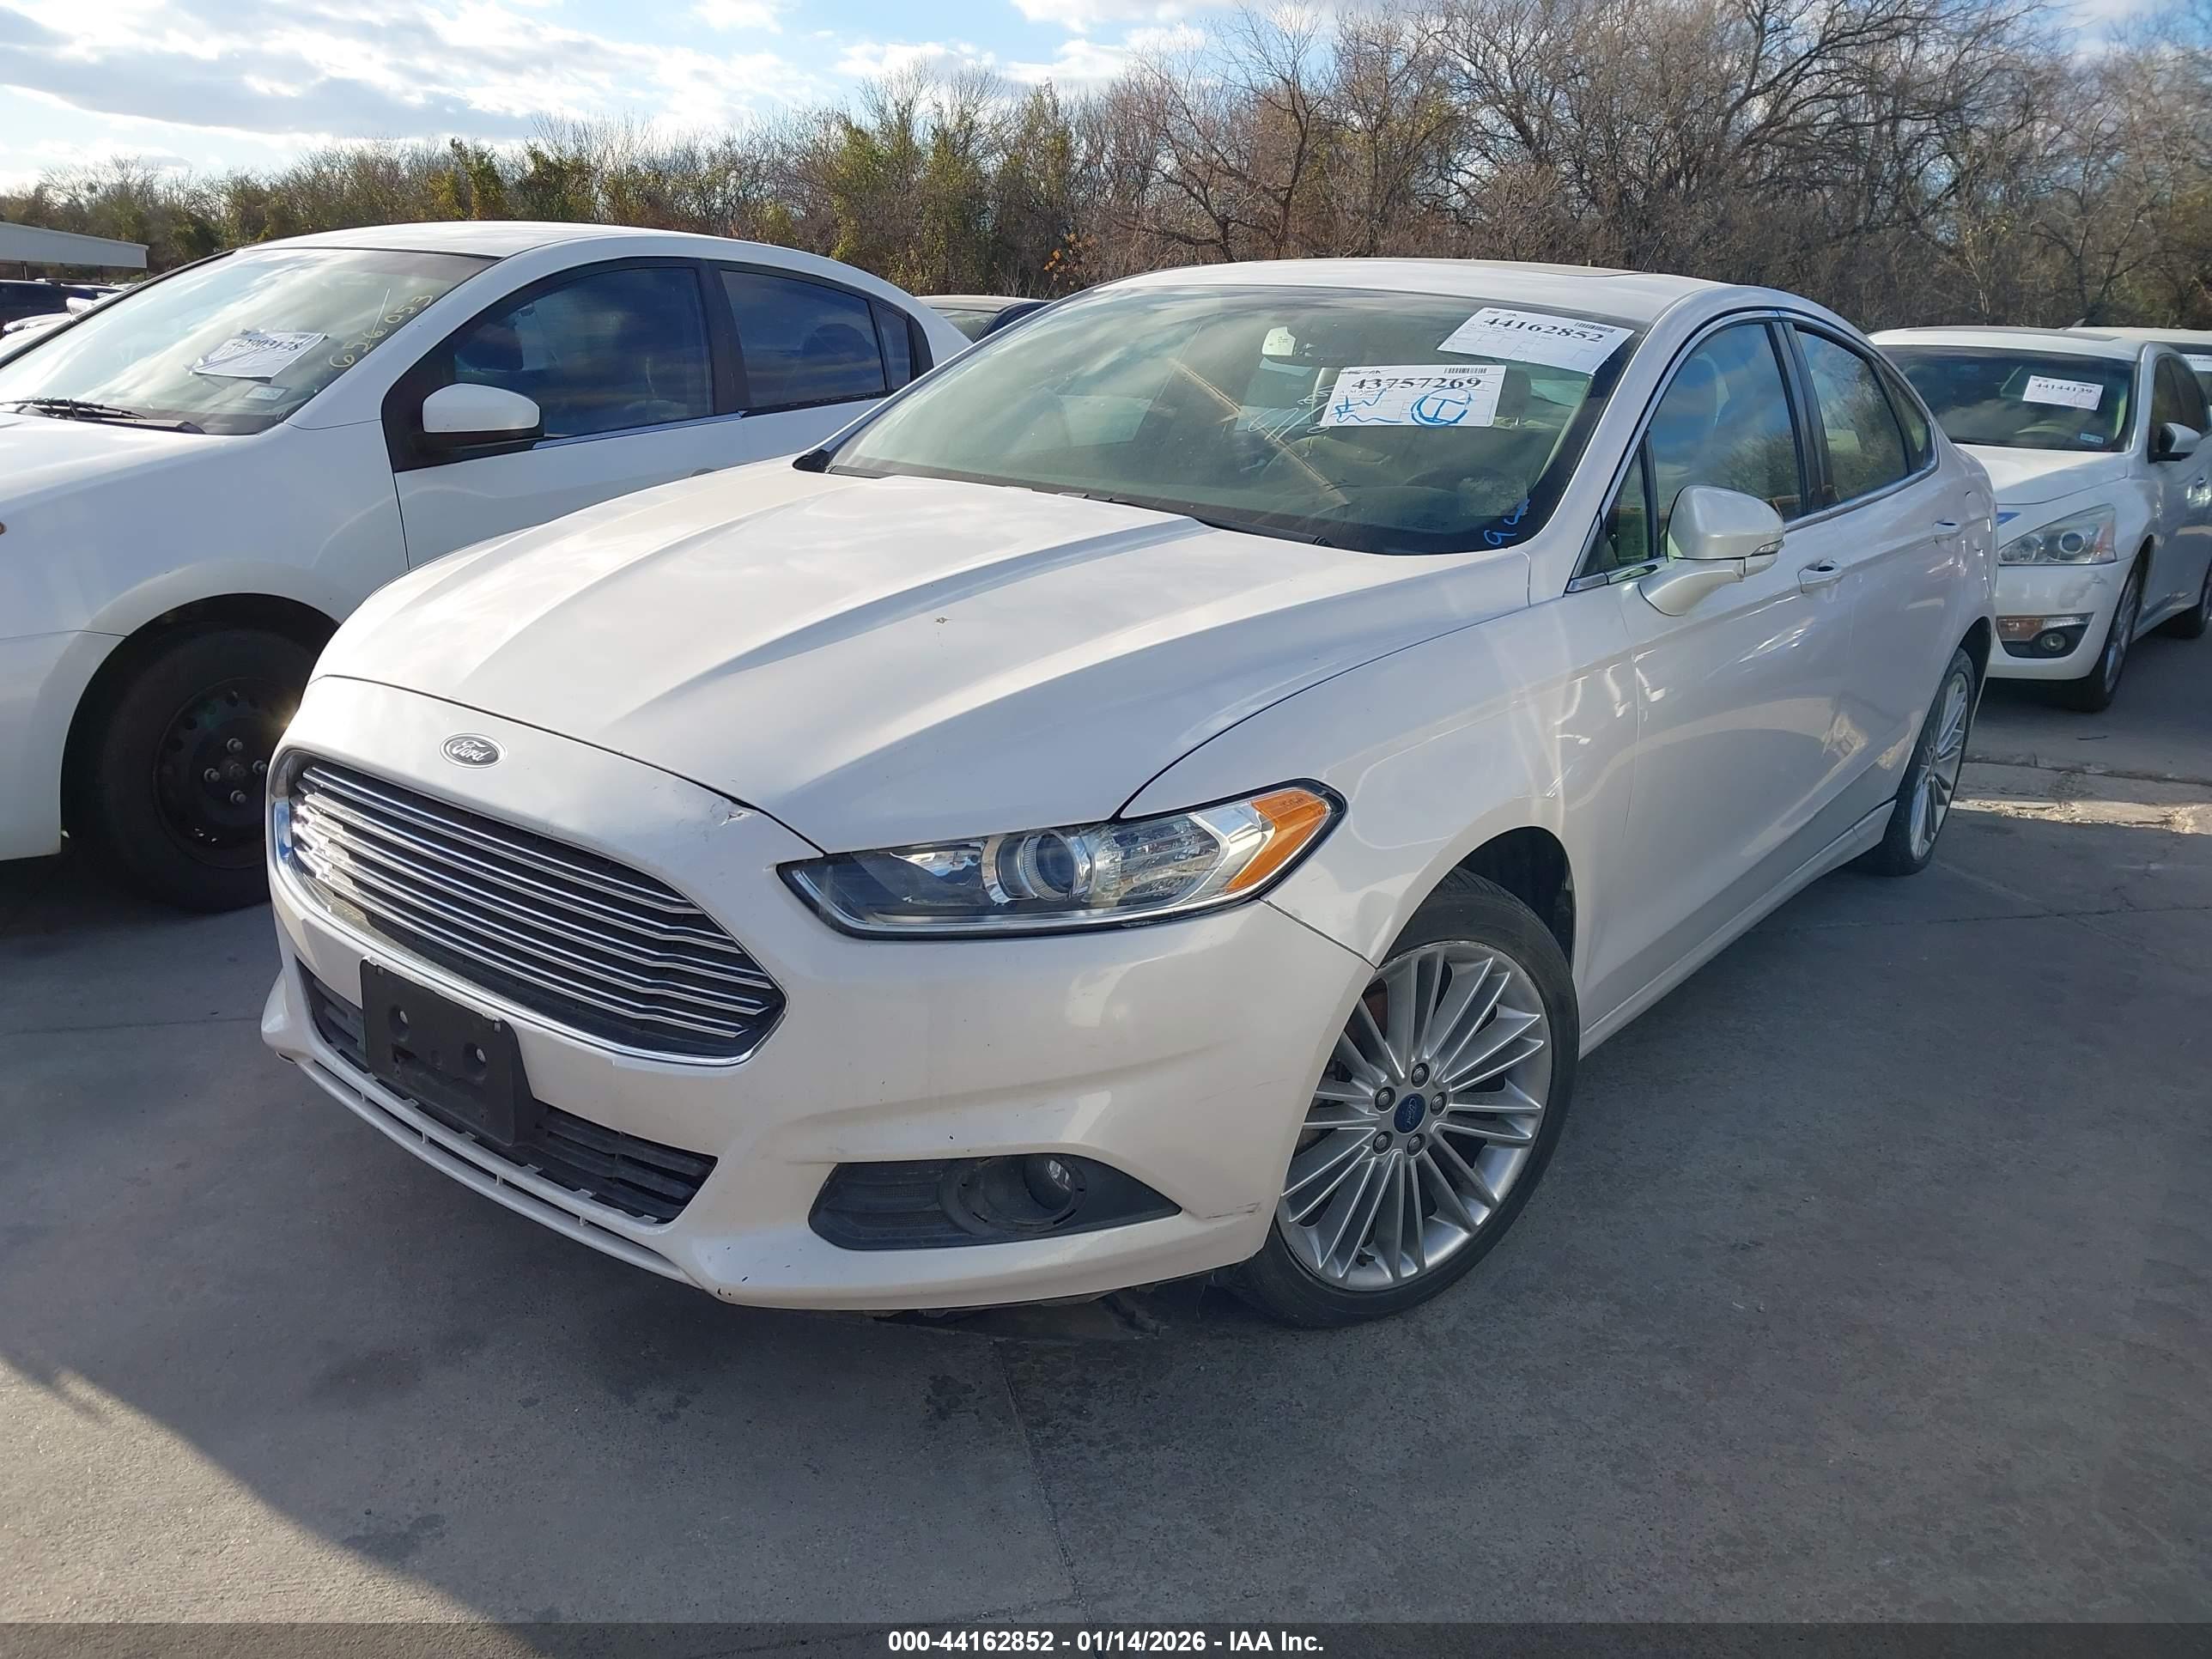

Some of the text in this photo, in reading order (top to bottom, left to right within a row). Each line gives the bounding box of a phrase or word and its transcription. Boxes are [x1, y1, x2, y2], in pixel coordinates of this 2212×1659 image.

[1483, 317, 1604, 343] 44162852
[1351, 377, 1482, 390] 43757269
[452, 739, 492, 762] Ford
